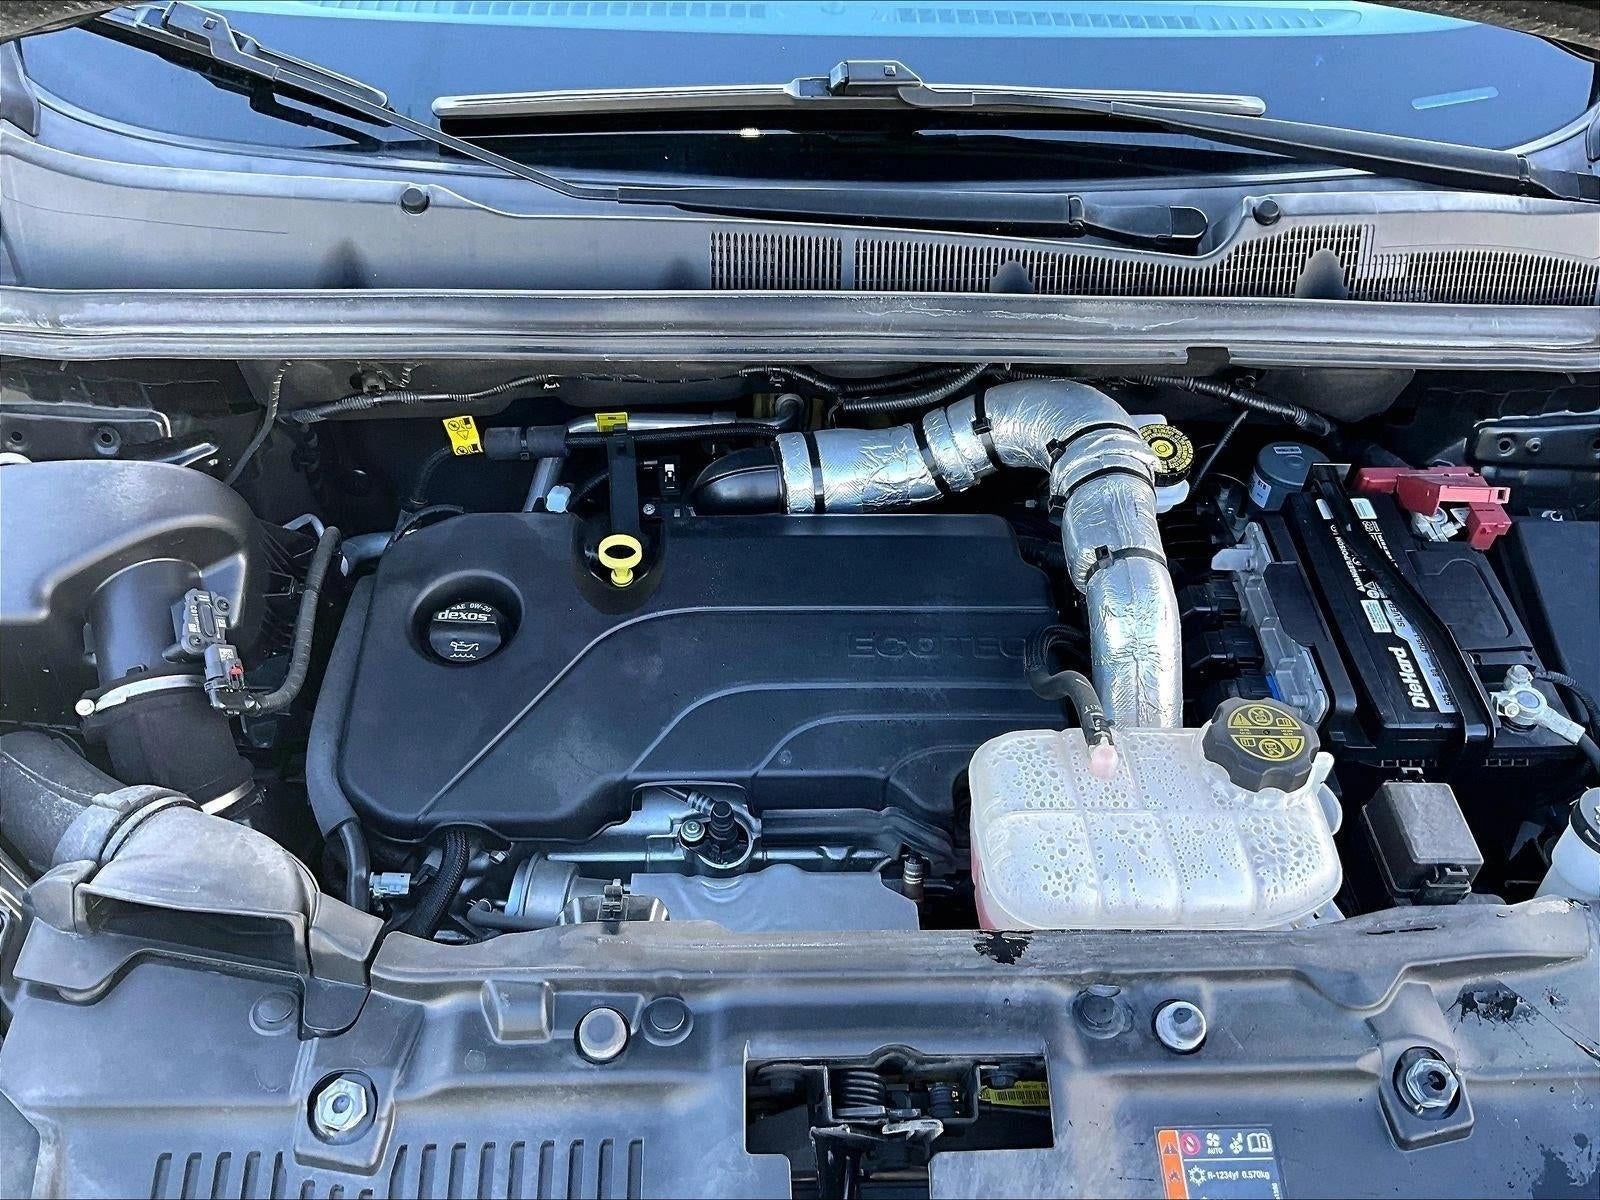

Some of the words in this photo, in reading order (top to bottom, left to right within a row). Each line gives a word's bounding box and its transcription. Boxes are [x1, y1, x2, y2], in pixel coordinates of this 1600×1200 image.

[470, 603, 492, 612] 0W-20
[438, 610, 491, 621] dexos
[1389, 602, 1405, 627] SILVER
[847, 637, 1027, 659] ECOTEC
[1387, 646, 1431, 708] DieHard
[1207, 1147, 1223, 1155] AUTO
[1242, 1170, 1270, 1180] 0.570kg
